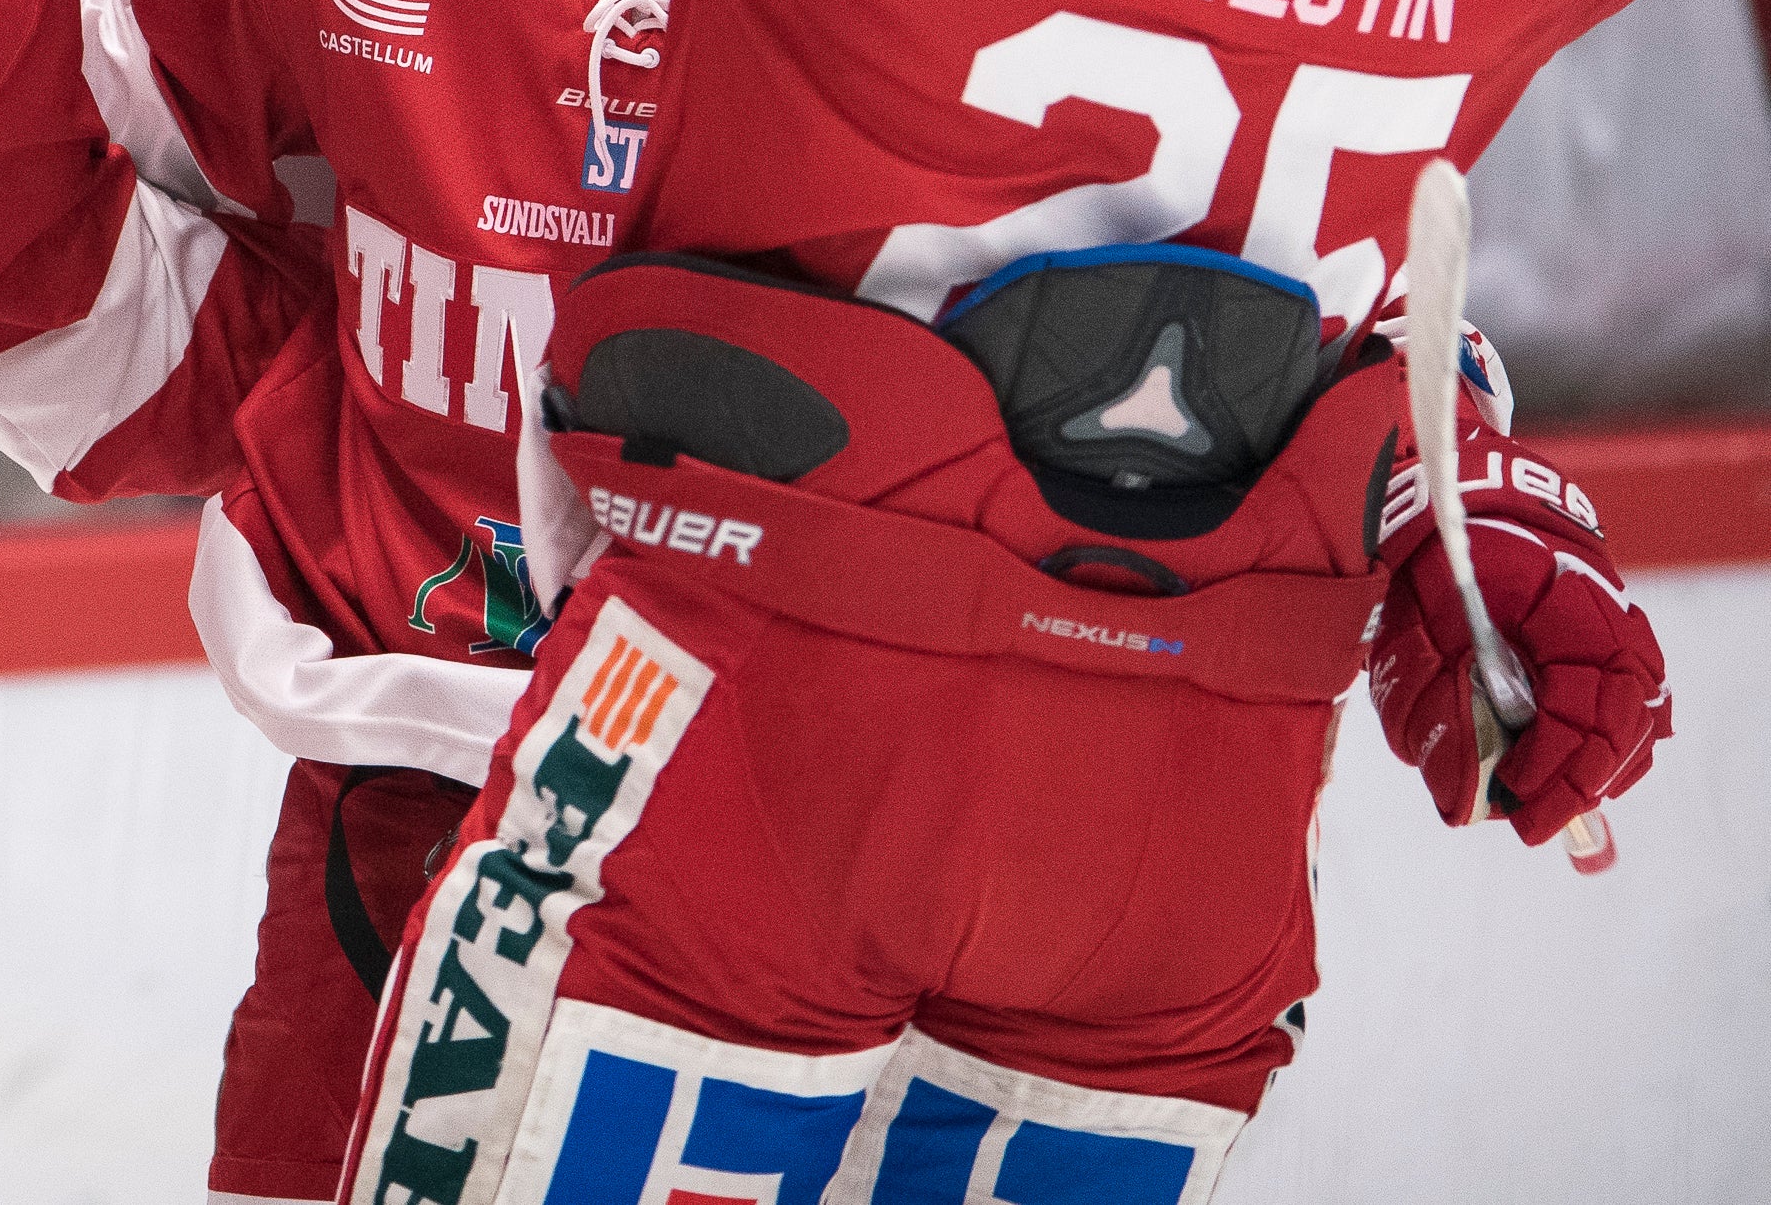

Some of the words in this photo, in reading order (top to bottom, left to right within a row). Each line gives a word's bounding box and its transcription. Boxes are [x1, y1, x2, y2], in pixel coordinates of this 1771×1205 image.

[319, 28, 433, 75] CASTELLUM
[587, 124, 649, 190] ST
[860, 11, 1473, 330] 25
[1021, 611, 1150, 652] NEXUS
